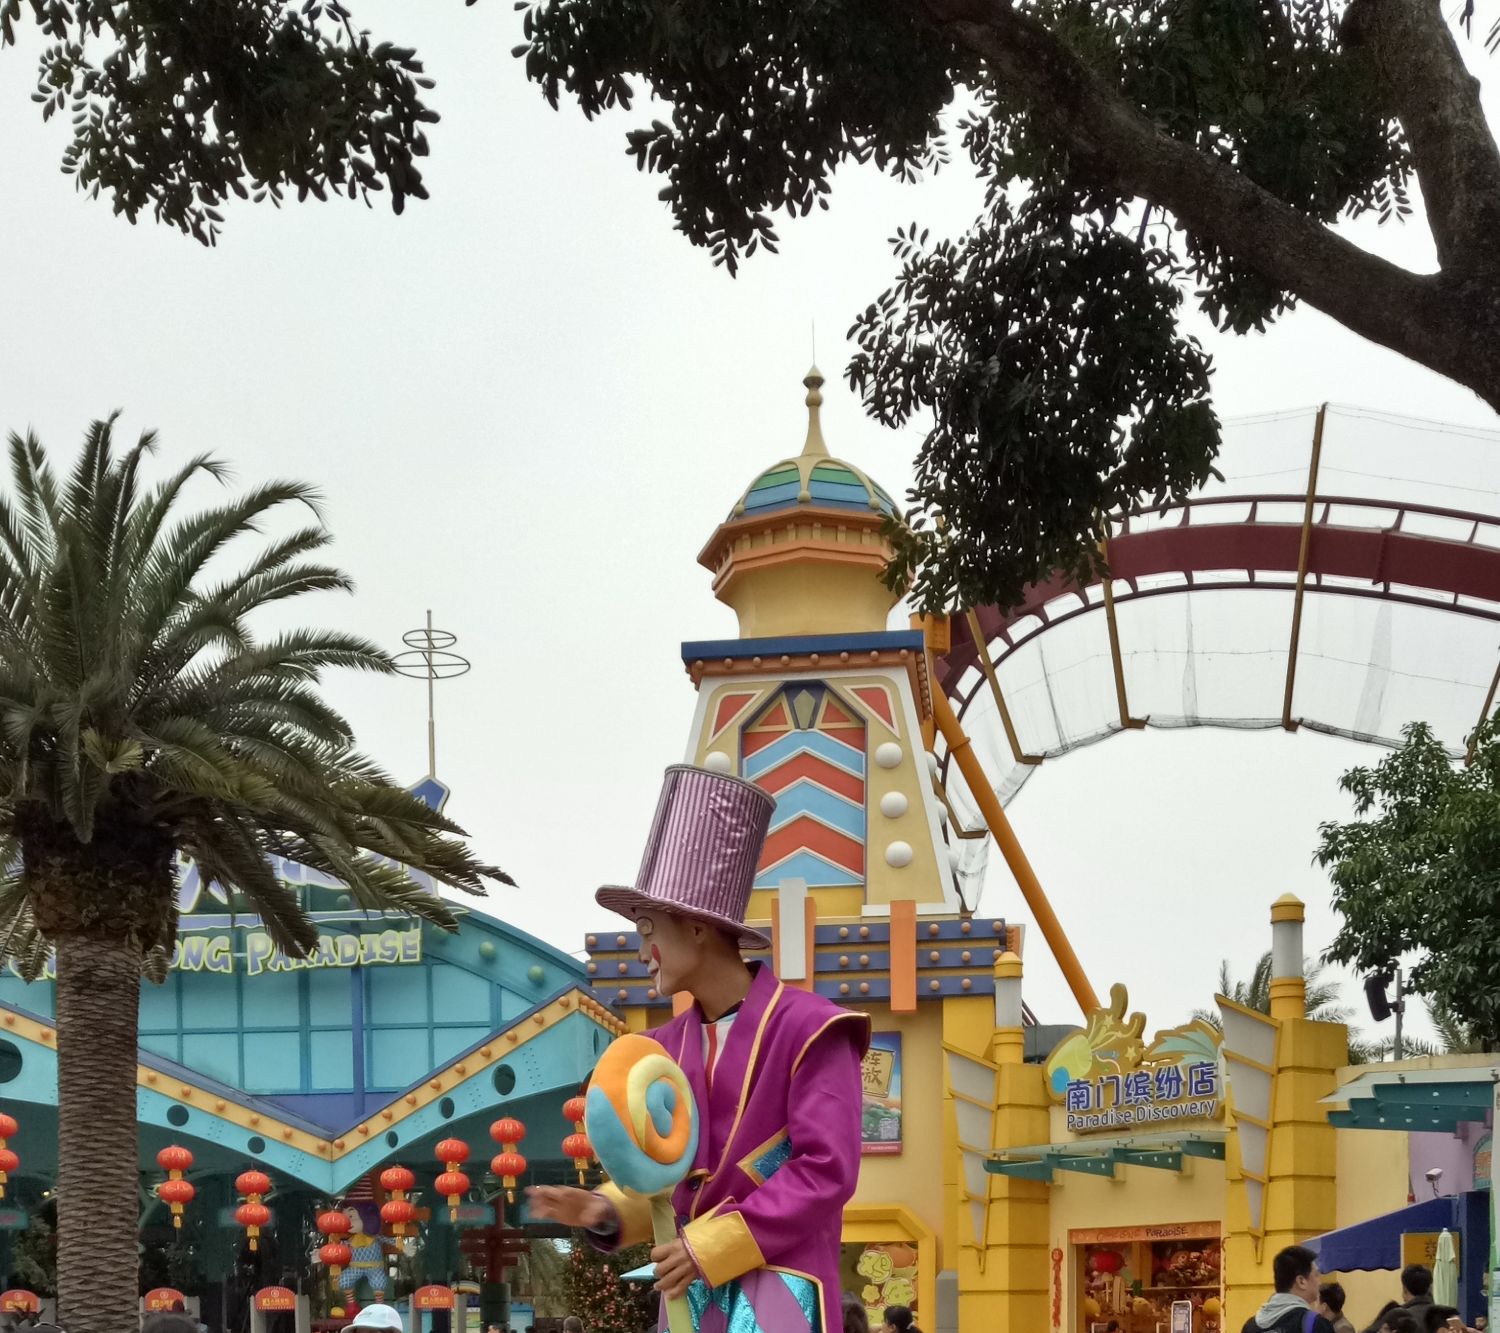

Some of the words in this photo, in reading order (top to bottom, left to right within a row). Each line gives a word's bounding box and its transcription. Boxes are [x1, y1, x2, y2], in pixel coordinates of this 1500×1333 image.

[1066, 1061, 1216, 1112] 南门缤纷店
[1067, 1110, 1132, 1130] Paradise
[1136, 1099, 1216, 1122] Discovery
